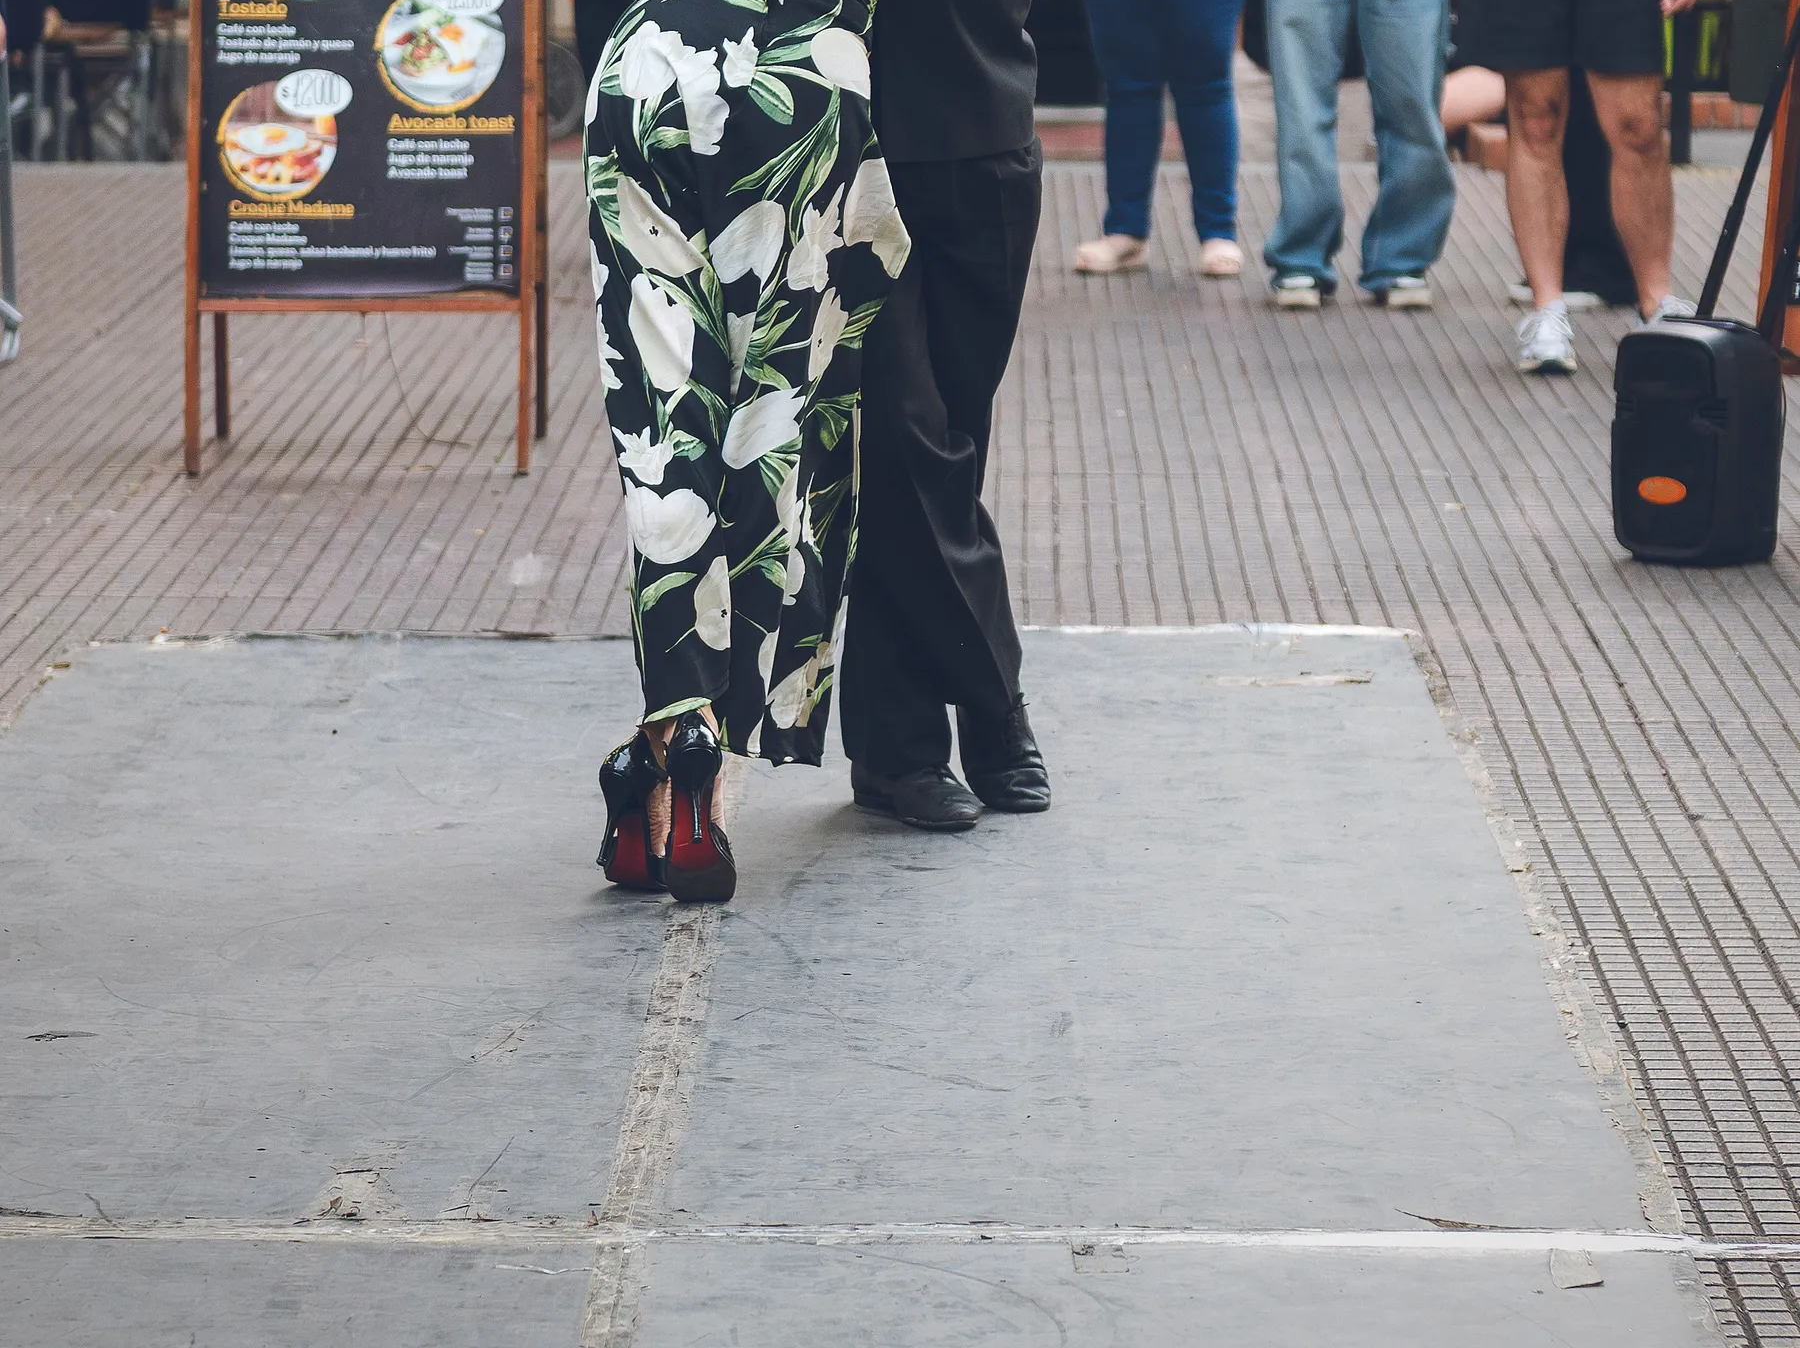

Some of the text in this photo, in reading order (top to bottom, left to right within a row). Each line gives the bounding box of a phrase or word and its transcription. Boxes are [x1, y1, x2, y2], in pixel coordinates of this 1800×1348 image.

[218, 0, 288, 15] Tostado
[217, 23, 297, 36] Café con leche
[217, 36, 354, 52] Tostado de jamón y queso
[217, 50, 301, 65] Jugo de naranja
[388, 112, 515, 130] Avocado toast
[387, 138, 470, 151] Café con leche
[387, 152, 475, 167] Jugo de naranja
[387, 166, 468, 179] Avocado toast
[228, 199, 355, 216] Croque Madame
